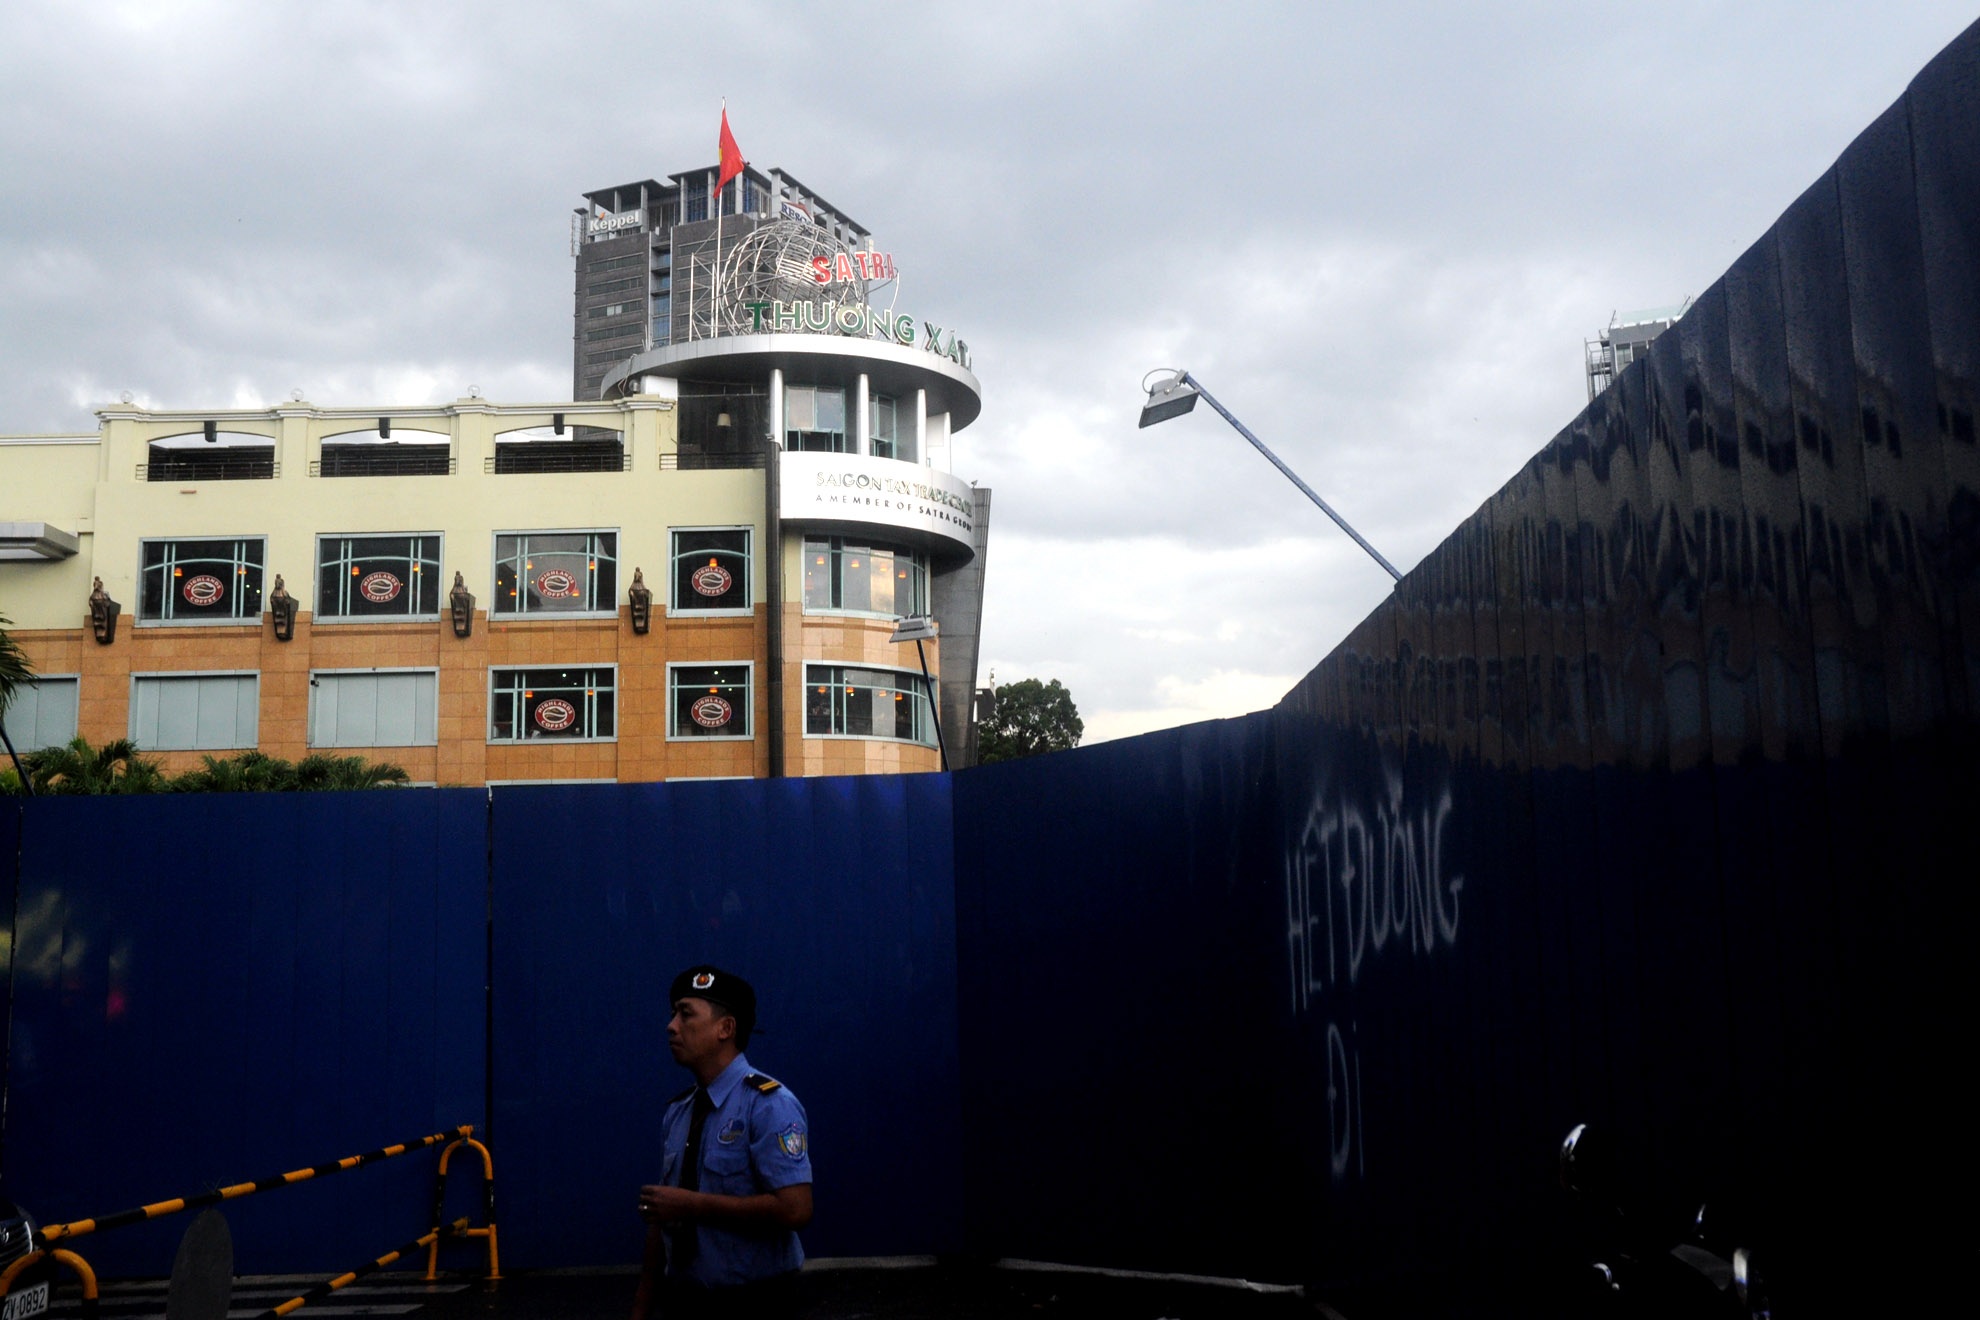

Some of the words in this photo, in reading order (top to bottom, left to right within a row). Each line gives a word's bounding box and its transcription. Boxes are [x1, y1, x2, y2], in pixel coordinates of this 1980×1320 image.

[590, 210, 639, 231] Keppel
[812, 251, 895, 285] SATRA
[816, 471, 882, 491] SAIGON
[816, 494, 823, 502] A
[829, 495, 890, 508] MEMBER
[896, 502, 911, 512] OF
[919, 505, 950, 521] SATRA
[363, 574, 398, 586] HIGHLANDS
[540, 570, 575, 584] HIGHLANDS
[694, 567, 729, 580] HIGHLANDS
[186, 577, 222, 590] HIGHLANDS
[366, 593, 394, 601] COFFEE
[543, 589, 569, 597] COFFEE
[698, 587, 724, 595] COFFEE
[190, 596, 217, 604] COFFEE
[538, 701, 573, 715] HIGHLANDS
[694, 698, 729, 711] HIGHLANDS
[541, 720, 568, 728] COFFEE
[697, 717, 724, 725] COFFEE
